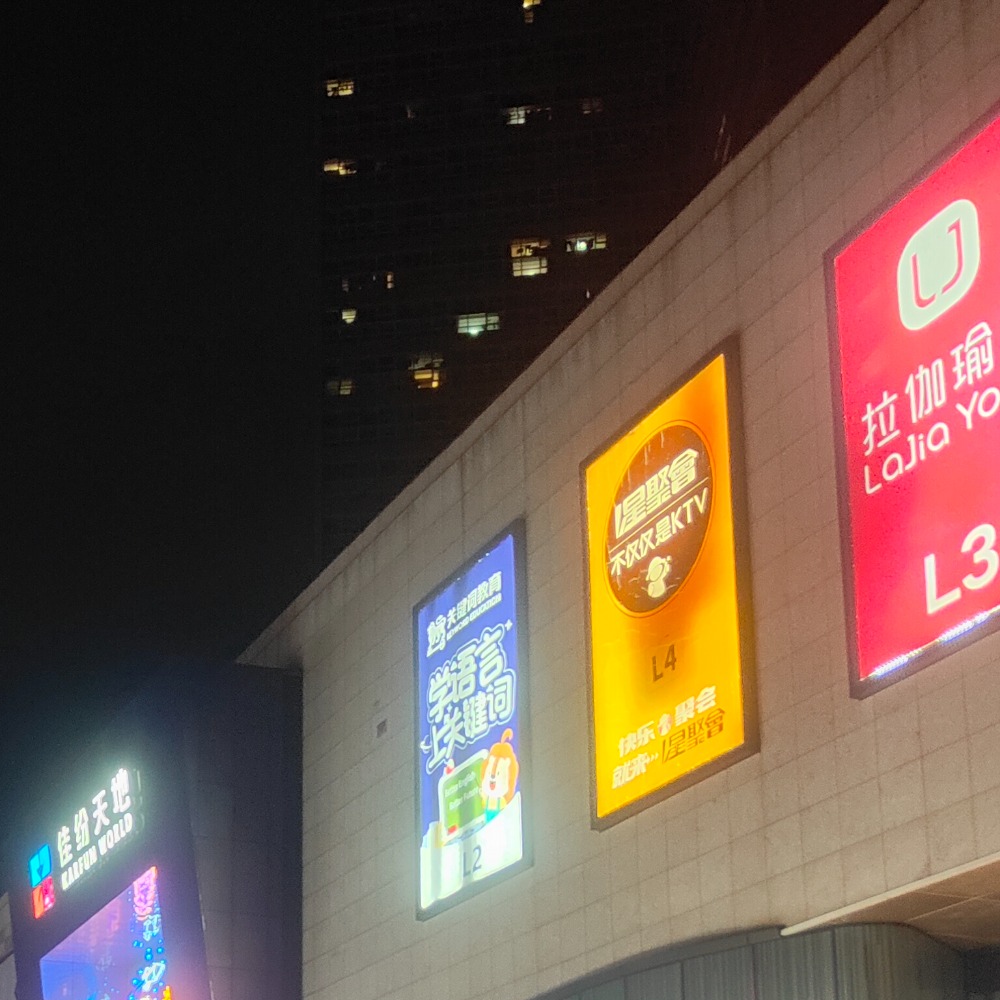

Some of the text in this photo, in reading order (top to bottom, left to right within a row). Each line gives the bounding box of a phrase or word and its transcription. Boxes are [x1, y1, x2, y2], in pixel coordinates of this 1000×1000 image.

[862, 321, 994, 457] 拉伽瑜
[863, 421, 950, 495] LaJia
[610, 486, 708, 577] 不仅仅是KTV
[446, 570, 502, 629] 关键词教育
[922, 523, 1000, 615] L3
[429, 630, 503, 722] 学语言
[652, 643, 677, 682] L4
[428, 680, 513, 770] 上关键词
[618, 685, 717, 758] 快乐 聚会
[98, 812, 132, 855] WORLD
[463, 845, 482, 877] L2
